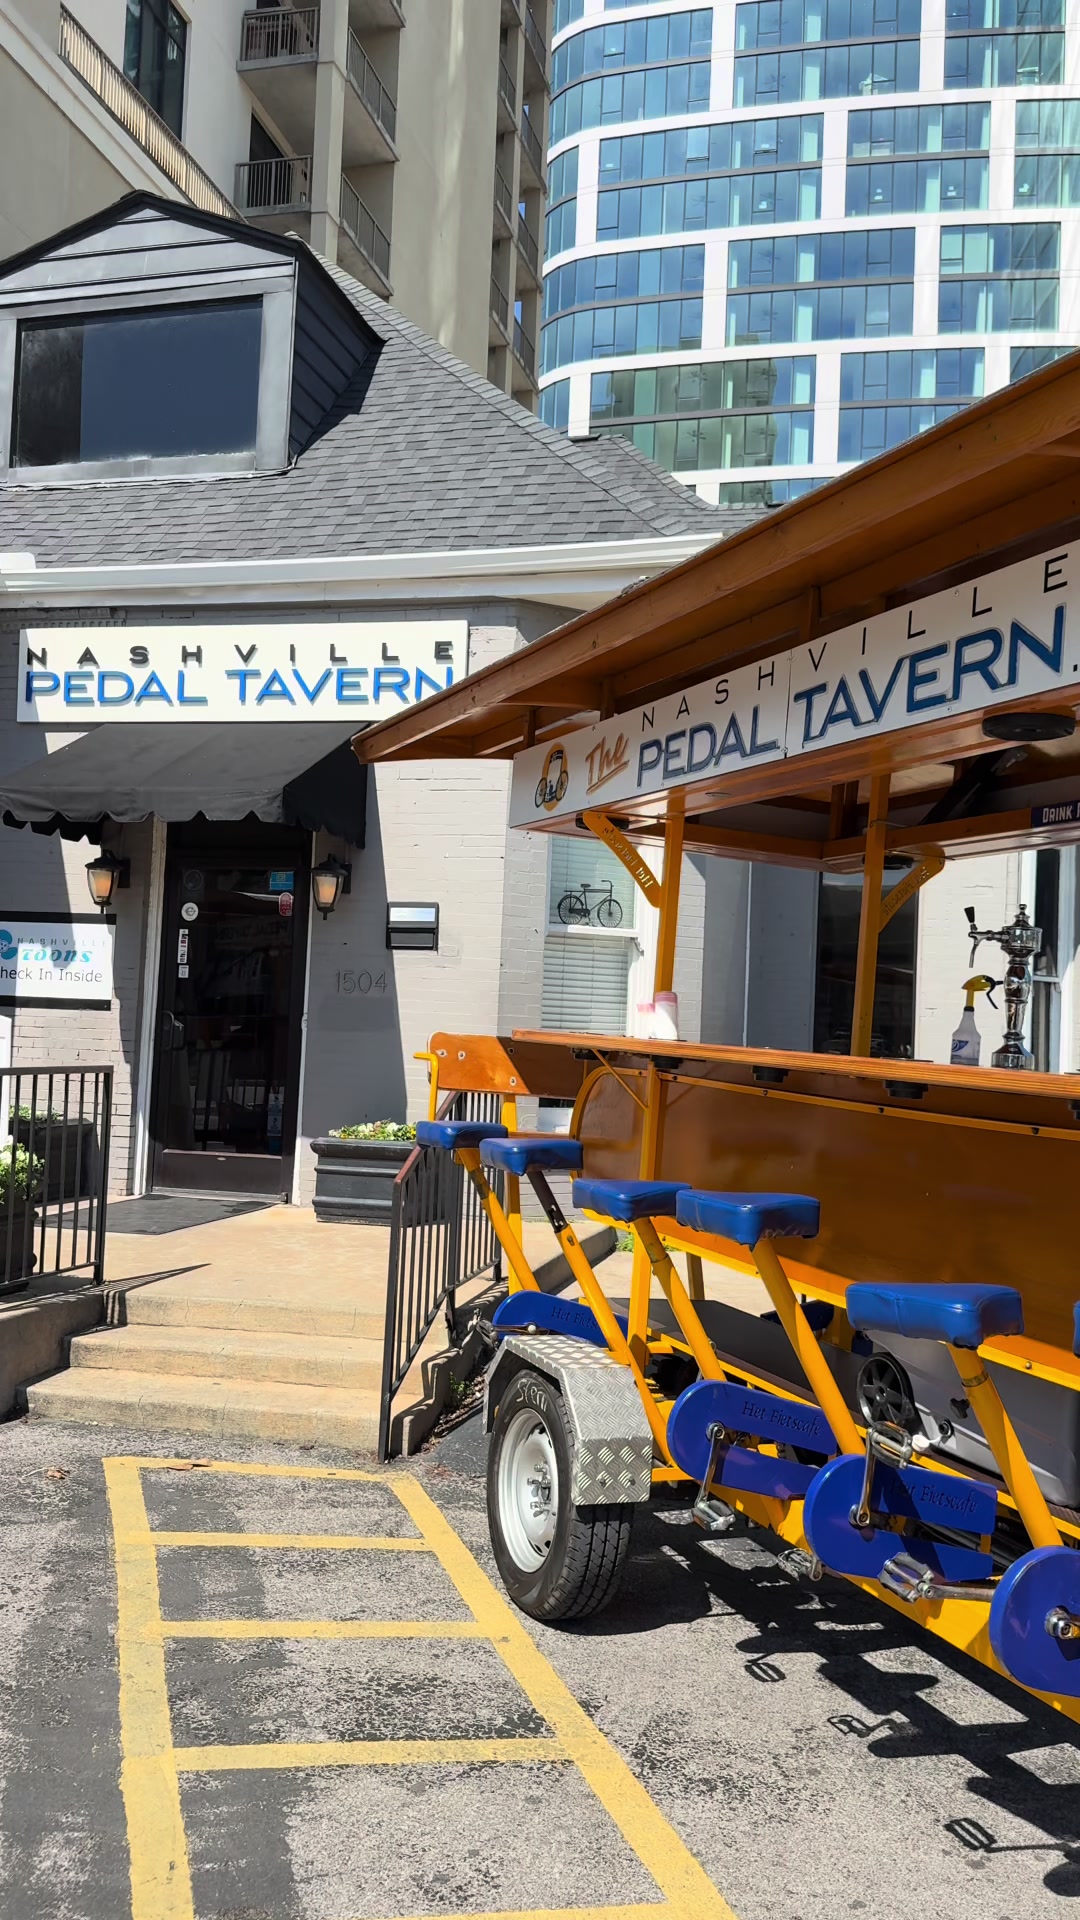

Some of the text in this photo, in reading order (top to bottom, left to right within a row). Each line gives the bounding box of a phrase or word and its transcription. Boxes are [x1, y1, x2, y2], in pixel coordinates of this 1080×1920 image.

[27, 640, 453, 667] NASHVILLE
[641, 552, 1069, 733] NASHVILLE
[25, 666, 454, 706] PEDAL TAVERN
[584, 602, 1067, 790] The PEDAL TAVERN
[1042, 805, 1073, 824] DRINK
[0, 966, 103, 983] heck In Inside
[335, 970, 388, 994] 1504
[742, 1401, 766, 1420] Het
